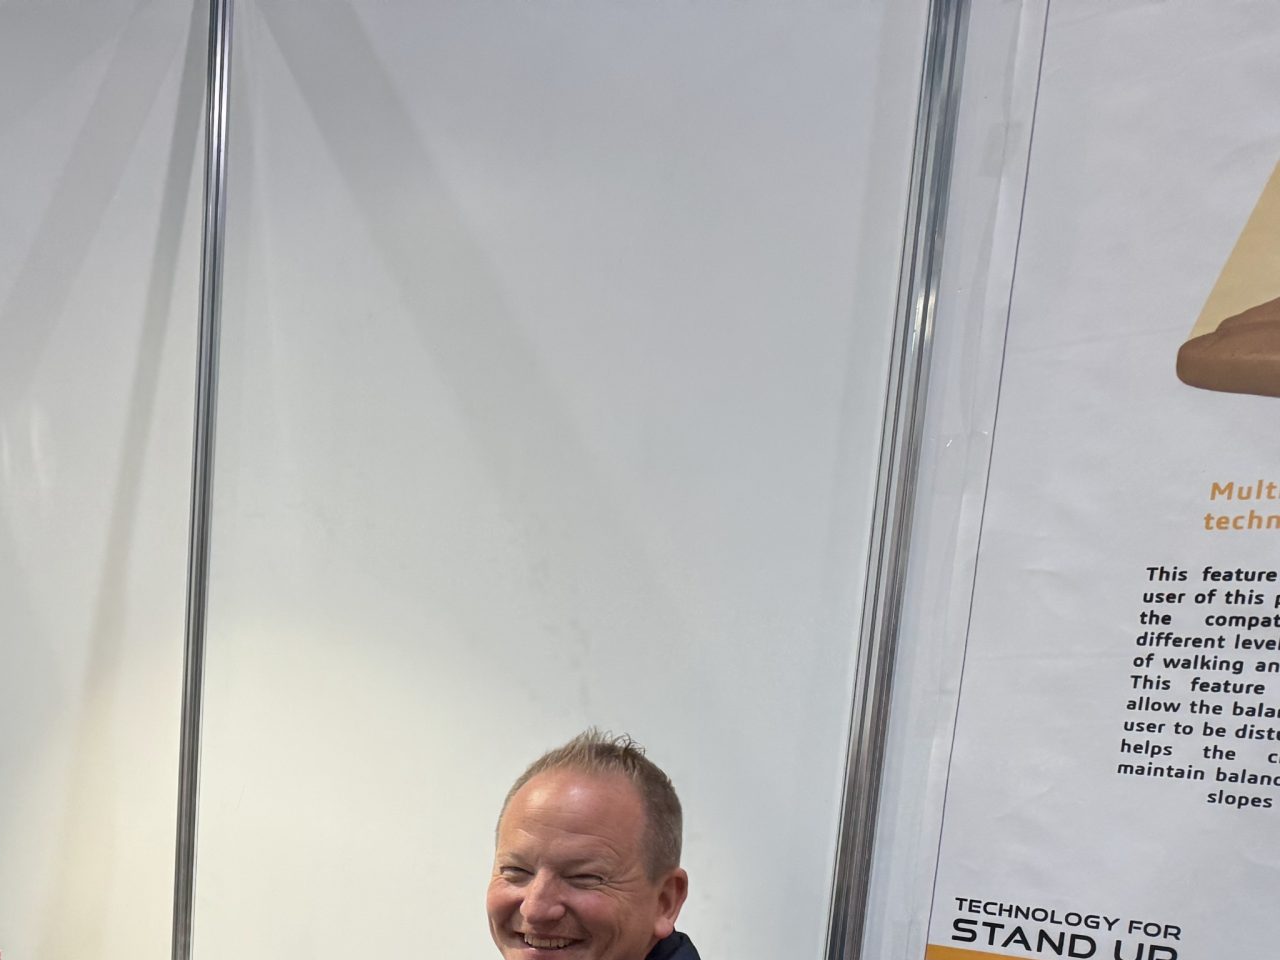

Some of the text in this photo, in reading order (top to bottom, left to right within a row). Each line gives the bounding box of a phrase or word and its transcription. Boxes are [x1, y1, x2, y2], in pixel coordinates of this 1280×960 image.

[1210, 479, 1280, 500] Mult
[1146, 567, 1277, 582] This feature
[1143, 592, 1186, 603] user
[1194, 589, 1217, 604] of
[1225, 590, 1264, 605] this
[1140, 610, 1172, 625] the
[1136, 632, 1226, 648] different
[1133, 653, 1280, 674] of walking an
[1131, 675, 1265, 694] This feature
[1126, 697, 1181, 712] allow
[1190, 700, 1223, 715] the
[1123, 721, 1165, 733] user
[1174, 722, 1194, 735] to
[1202, 722, 1227, 737] be
[1120, 739, 1173, 758] helps
[1203, 745, 1236, 760] the
[1117, 762, 1205, 780] maintain
[1207, 790, 1272, 809] slopes
[955, 897, 1182, 940] TECHNOLOGY FOR
[951, 918, 1097, 959] STAND
